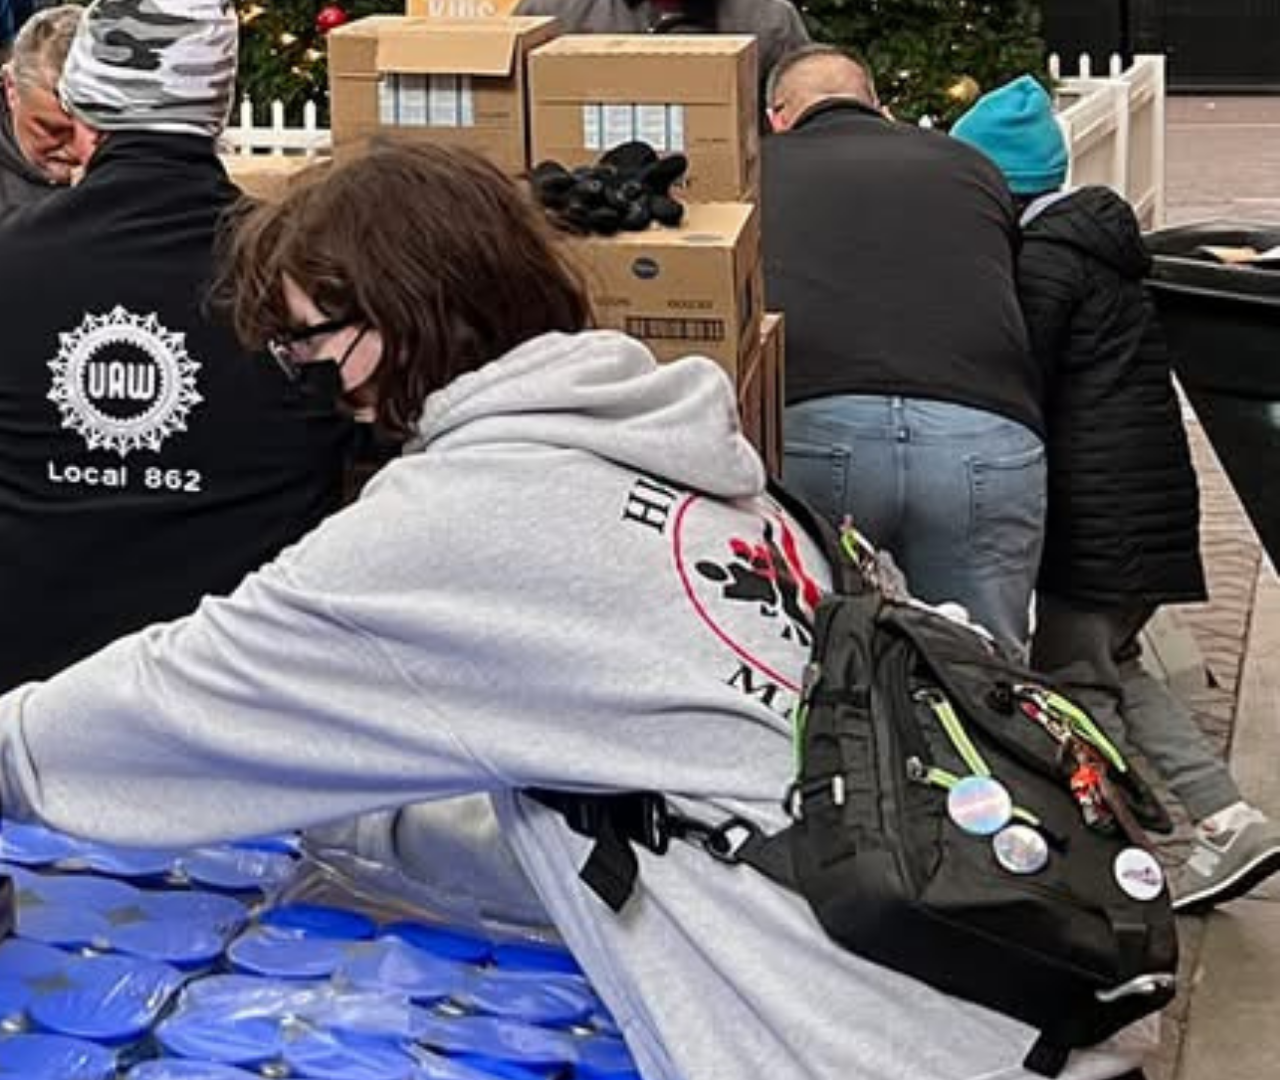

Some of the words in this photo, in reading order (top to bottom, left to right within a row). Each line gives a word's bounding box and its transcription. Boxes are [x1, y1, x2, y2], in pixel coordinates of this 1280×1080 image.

[89, 360, 156, 399] UAW
[47, 460, 127, 488] Local
[144, 467, 202, 493] 862
